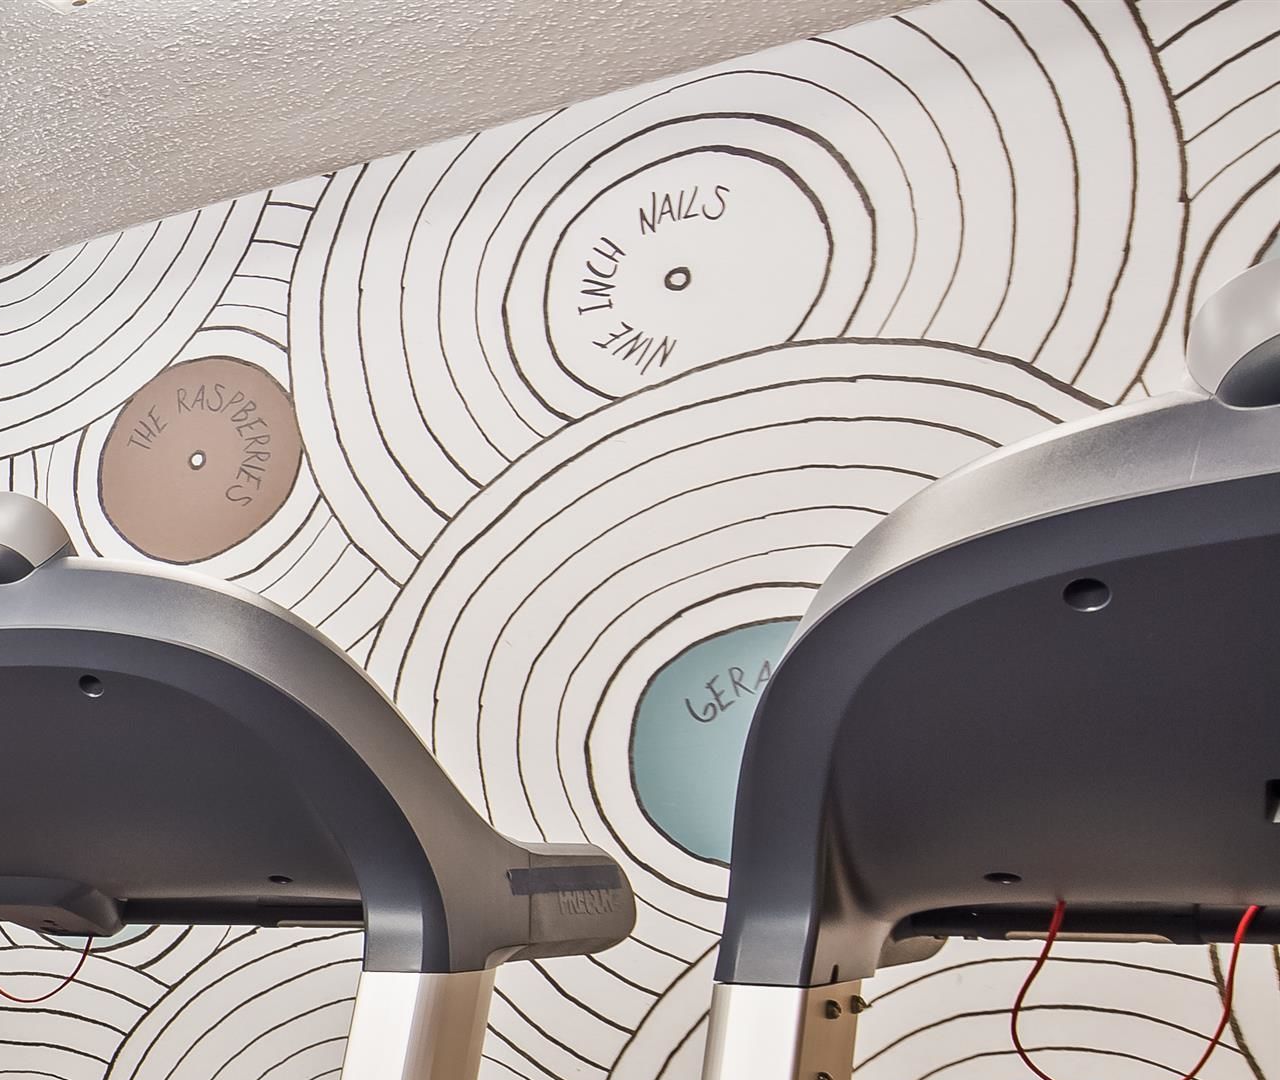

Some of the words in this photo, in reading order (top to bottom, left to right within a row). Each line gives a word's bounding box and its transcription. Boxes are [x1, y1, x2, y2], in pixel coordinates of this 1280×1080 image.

[639, 185, 730, 235] NAILS
[578, 237, 626, 315] INCH
[592, 321, 677, 376] NINE
[127, 404, 168, 450] THE
[177, 383, 271, 507] RASPBERRIES
[685, 660, 772, 723] GERA
